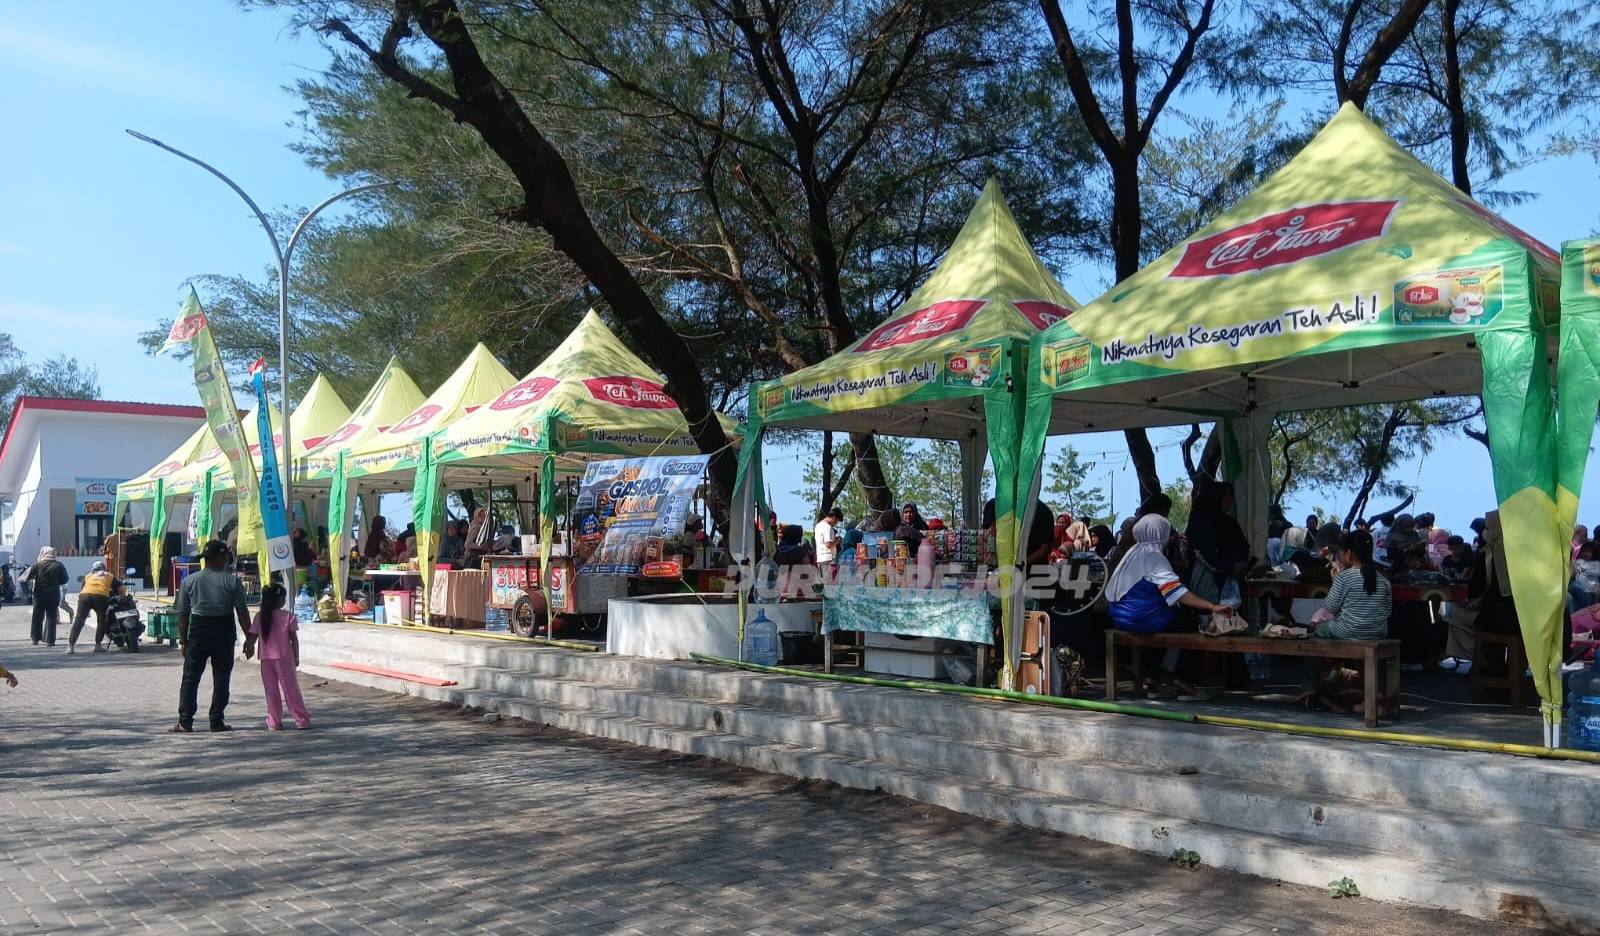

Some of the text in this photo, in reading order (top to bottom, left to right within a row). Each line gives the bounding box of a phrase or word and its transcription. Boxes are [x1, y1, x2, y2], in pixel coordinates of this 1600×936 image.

[1206, 216, 1356, 269] Teh Jawa
[1103, 334, 1185, 362] Nikmatnya
[1189, 319, 1281, 347] Kesegaran
[1285, 309, 1322, 330] Teh
[603, 380, 671, 402] Teh Jawa
[792, 381, 836, 401] Nikmatnya
[837, 376, 886, 395] Kesegaran
[888, 370, 907, 385] Teh
[608, 478, 670, 500] GASPOL
